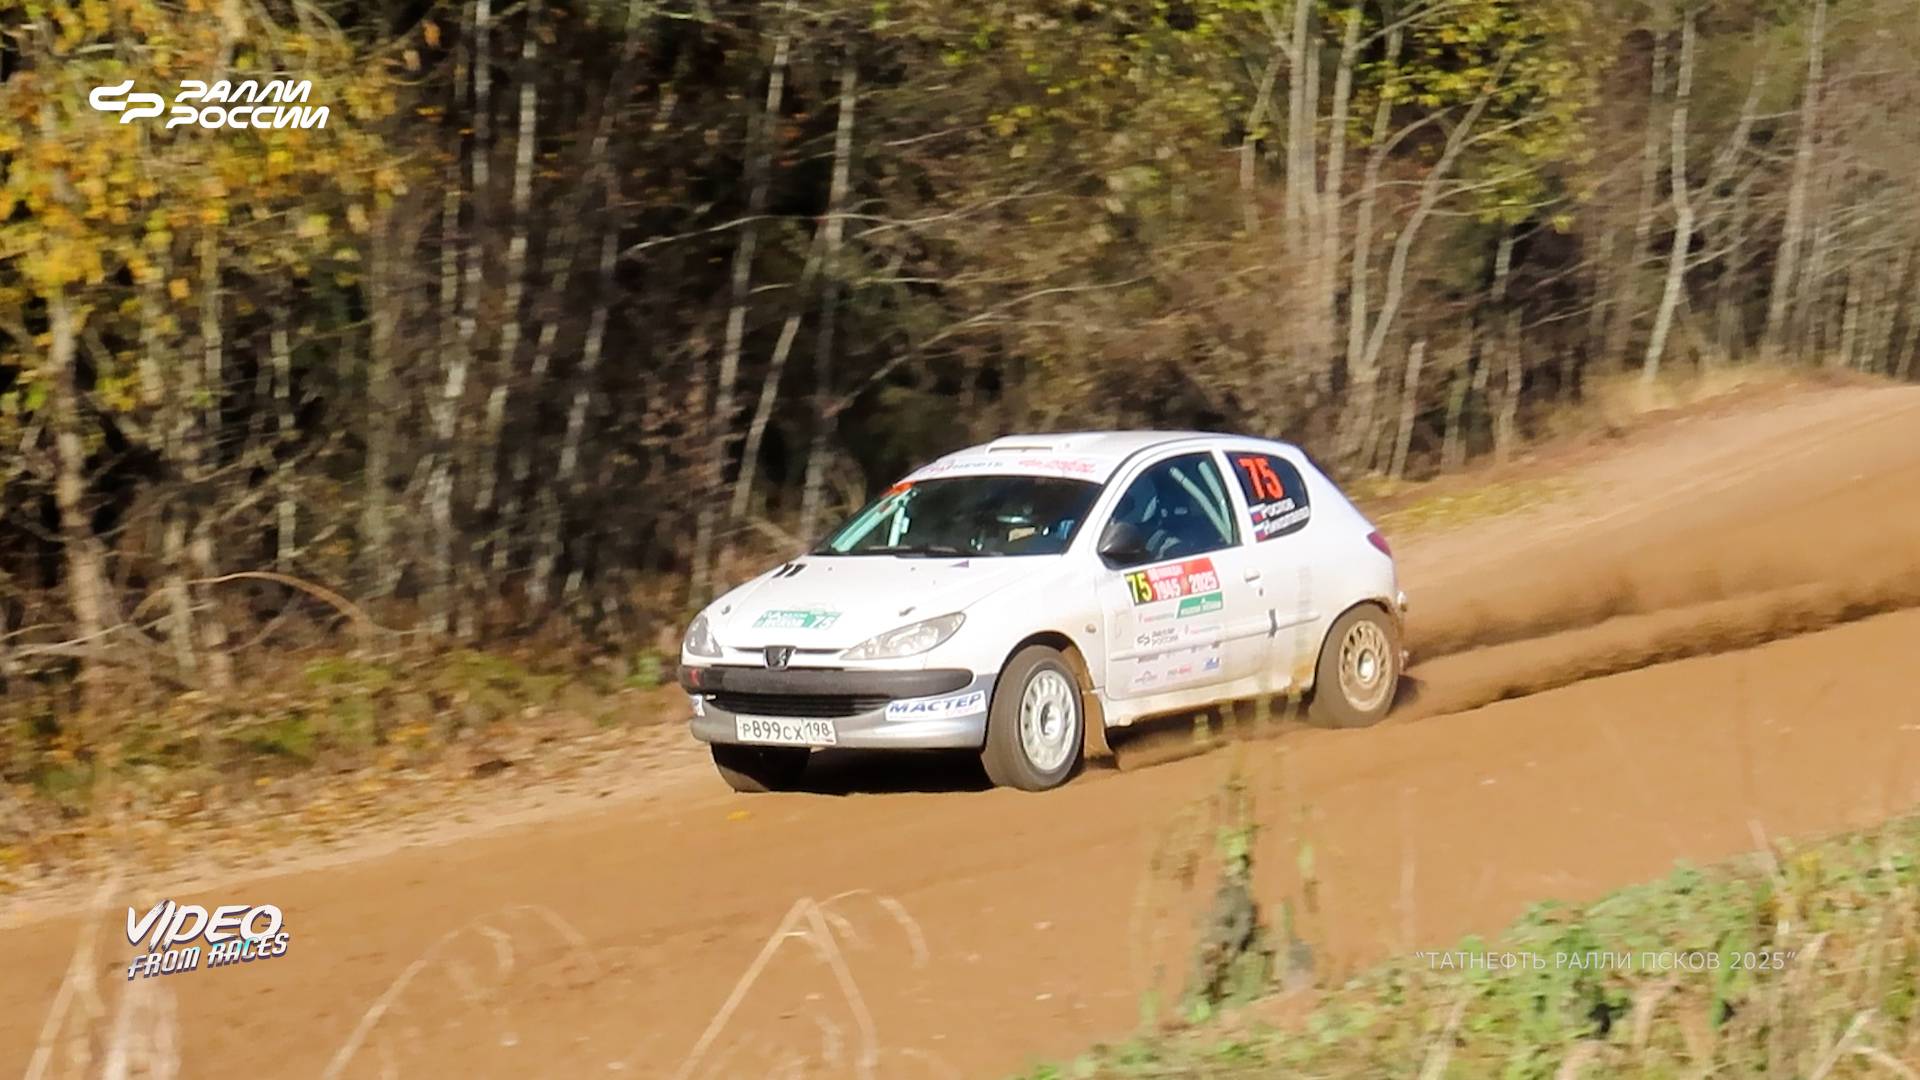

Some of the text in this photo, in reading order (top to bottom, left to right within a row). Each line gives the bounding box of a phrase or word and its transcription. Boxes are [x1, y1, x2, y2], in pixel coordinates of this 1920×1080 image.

[1237, 456, 1284, 500] 75
[1125, 572, 1153, 604] 75
[1153, 578, 1181, 601] 1945
[1188, 570, 1218, 593] 2025
[889, 693, 982, 713] МАСТЕР
